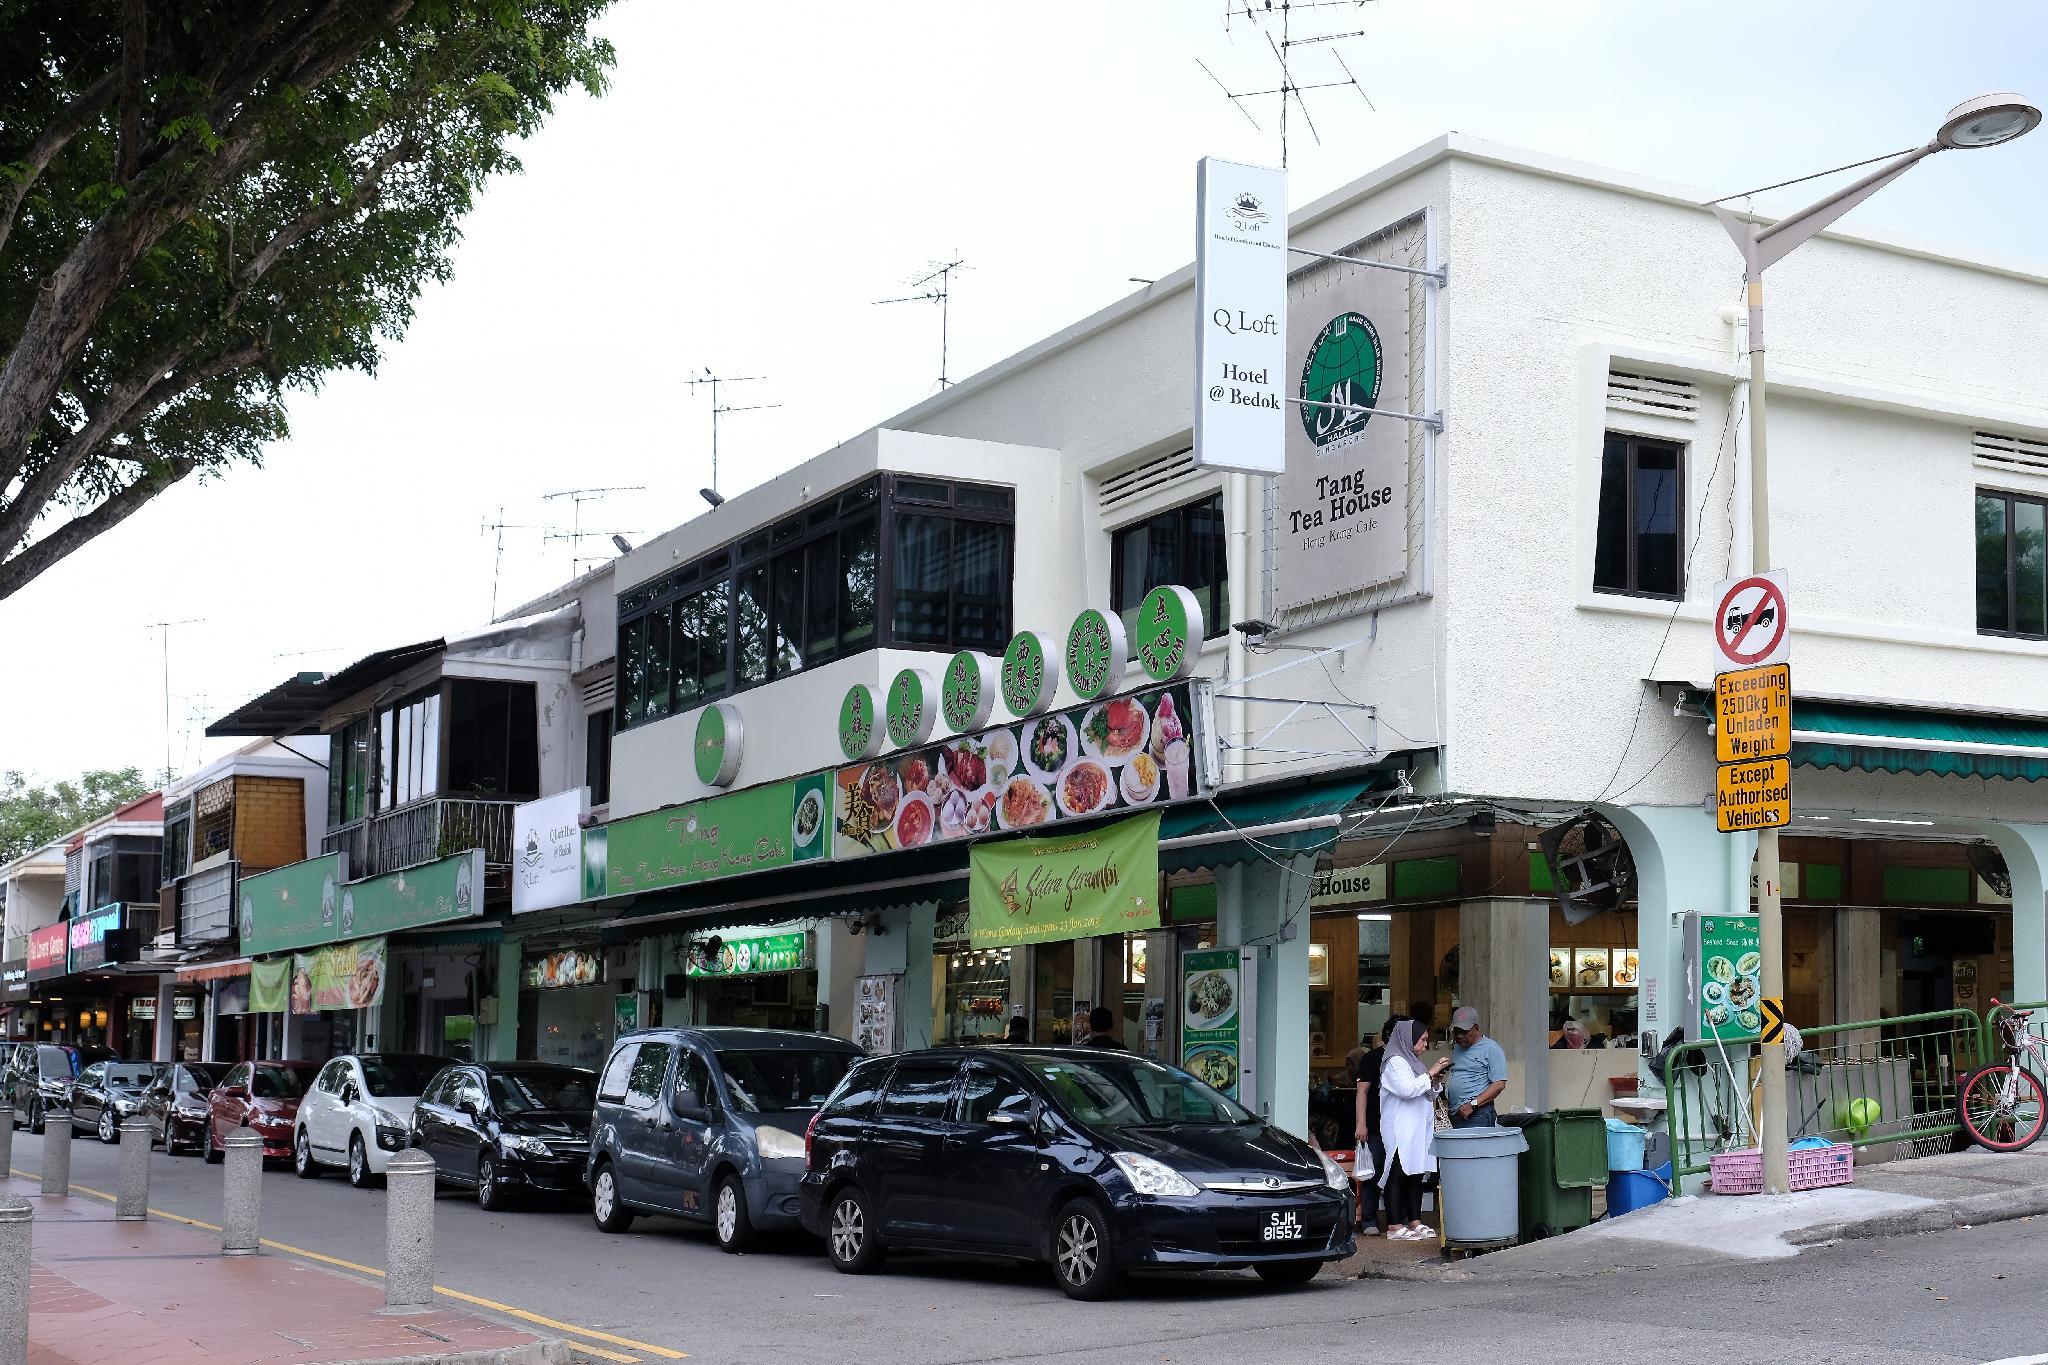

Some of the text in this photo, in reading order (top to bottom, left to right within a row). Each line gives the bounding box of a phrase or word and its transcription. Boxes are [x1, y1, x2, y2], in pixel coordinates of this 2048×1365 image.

[1213, 308, 1279, 335] Q Loft
[1222, 362, 1268, 384] Hotel
[1209, 385, 1281, 410] @ Bedok
[1316, 432, 1365, 457] SINGAPORE
[1327, 428, 1354, 443] HALAL
[1315, 468, 1365, 501] Tang
[1288, 486, 1392, 535] Tea House
[1302, 517, 1378, 551] Hong Kong Cafe
[1070, 627, 1082, 669] HOME
[1141, 636, 1184, 673] DIM SUM
[1005, 654, 1041, 710] WESTERN FOOD
[1073, 670, 1092, 692] MADE
[1719, 670, 1786, 696] Exceeding
[945, 671, 979, 728] CHICKEN RICE
[1722, 690, 1786, 716] 2500kg In
[1726, 713, 1779, 735] Unladen
[1731, 732, 1776, 757] Weight
[1730, 763, 1775, 785] Except
[1718, 782, 1789, 808] Authorised
[1725, 806, 1780, 828] Vehicles
[1024, 864, 1063, 916] Selera
[1318, 876, 1371, 896] House
[1703, 938, 1723, 946] Seafood
[1270, 1211, 1296, 1227] SJH
[1263, 1224, 1303, 1241] 8155Z
